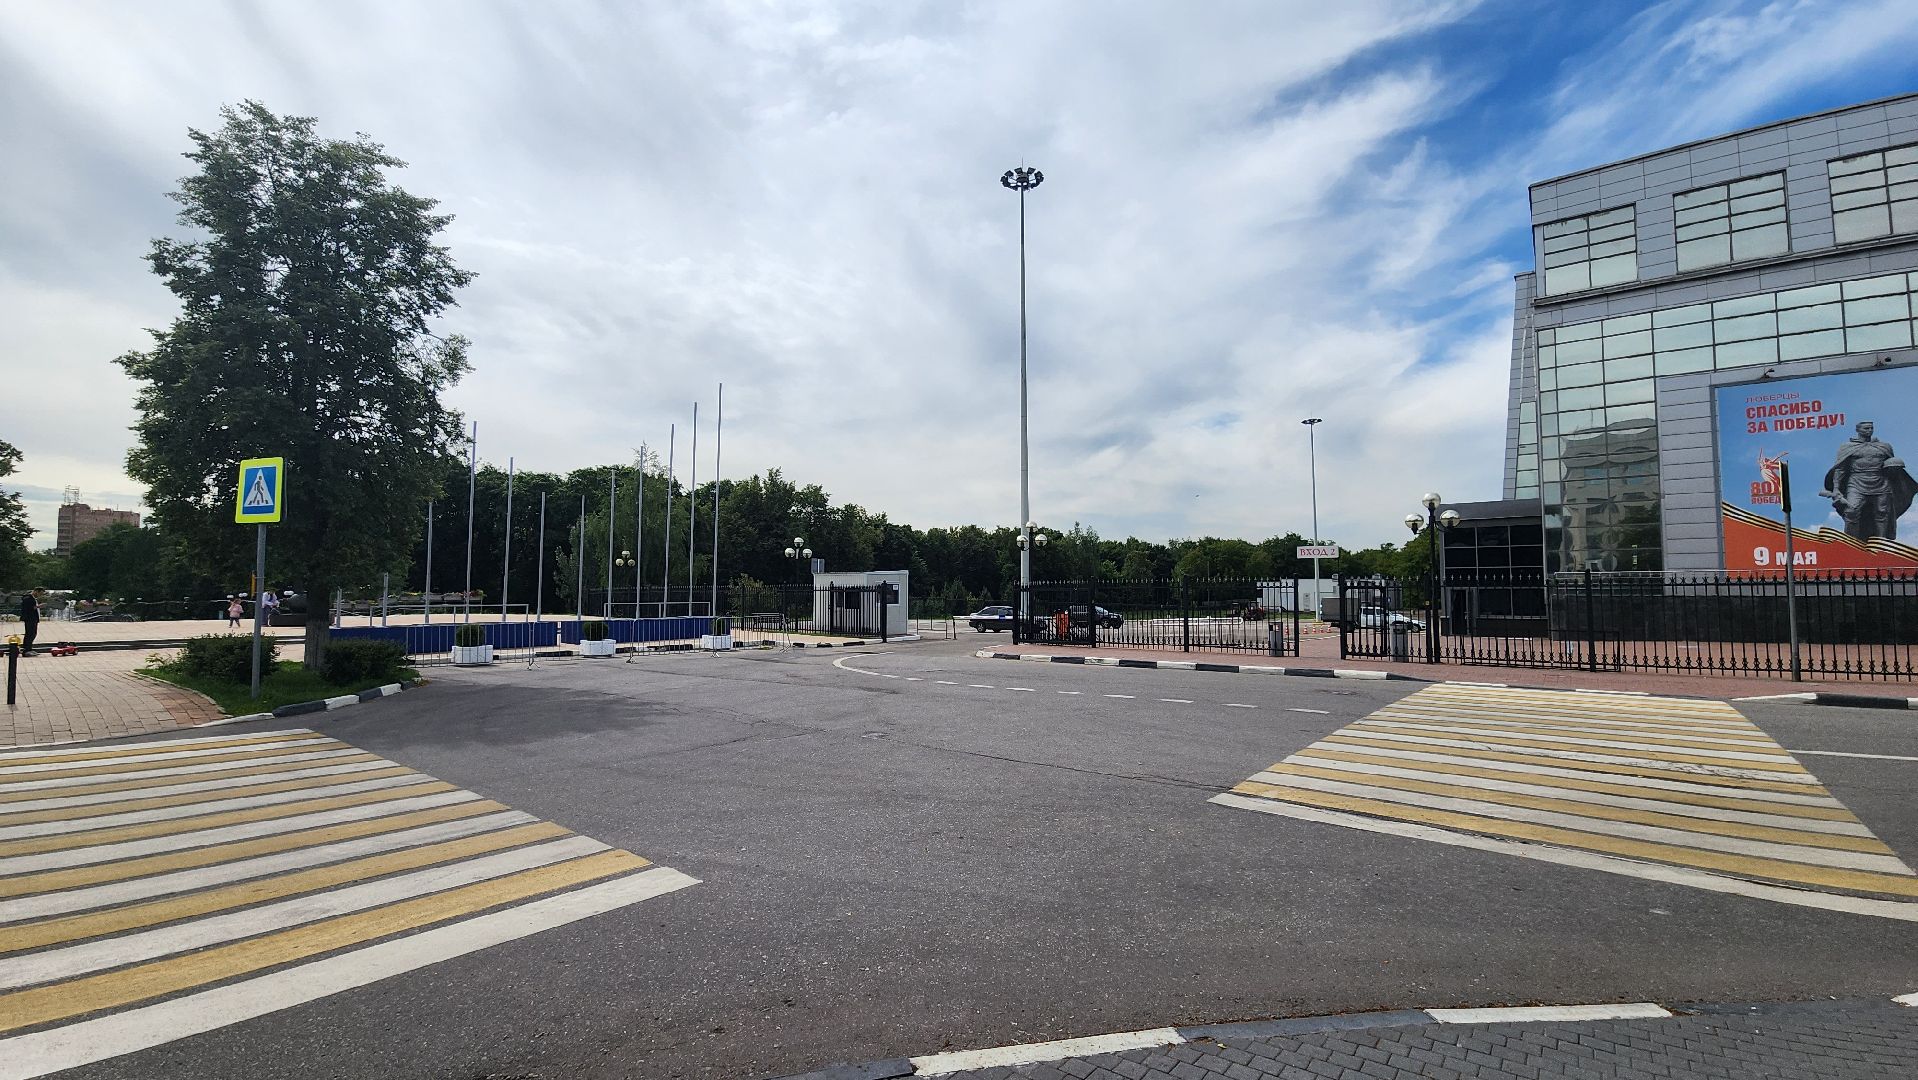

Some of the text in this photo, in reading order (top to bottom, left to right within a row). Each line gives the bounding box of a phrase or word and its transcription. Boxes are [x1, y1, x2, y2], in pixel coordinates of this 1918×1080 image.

[1745, 392, 1800, 403] ЛЮБЕРЦЫ
[1746, 400, 1822, 419] СПАСИБО
[1747, 413, 1845, 433] ЗА ПОБЕДУ!
[1751, 495, 1781, 504] ПОБЕД
[1300, 548, 1336, 556] ВХОД 2
[1754, 547, 1817, 566] 9 МАЯ
